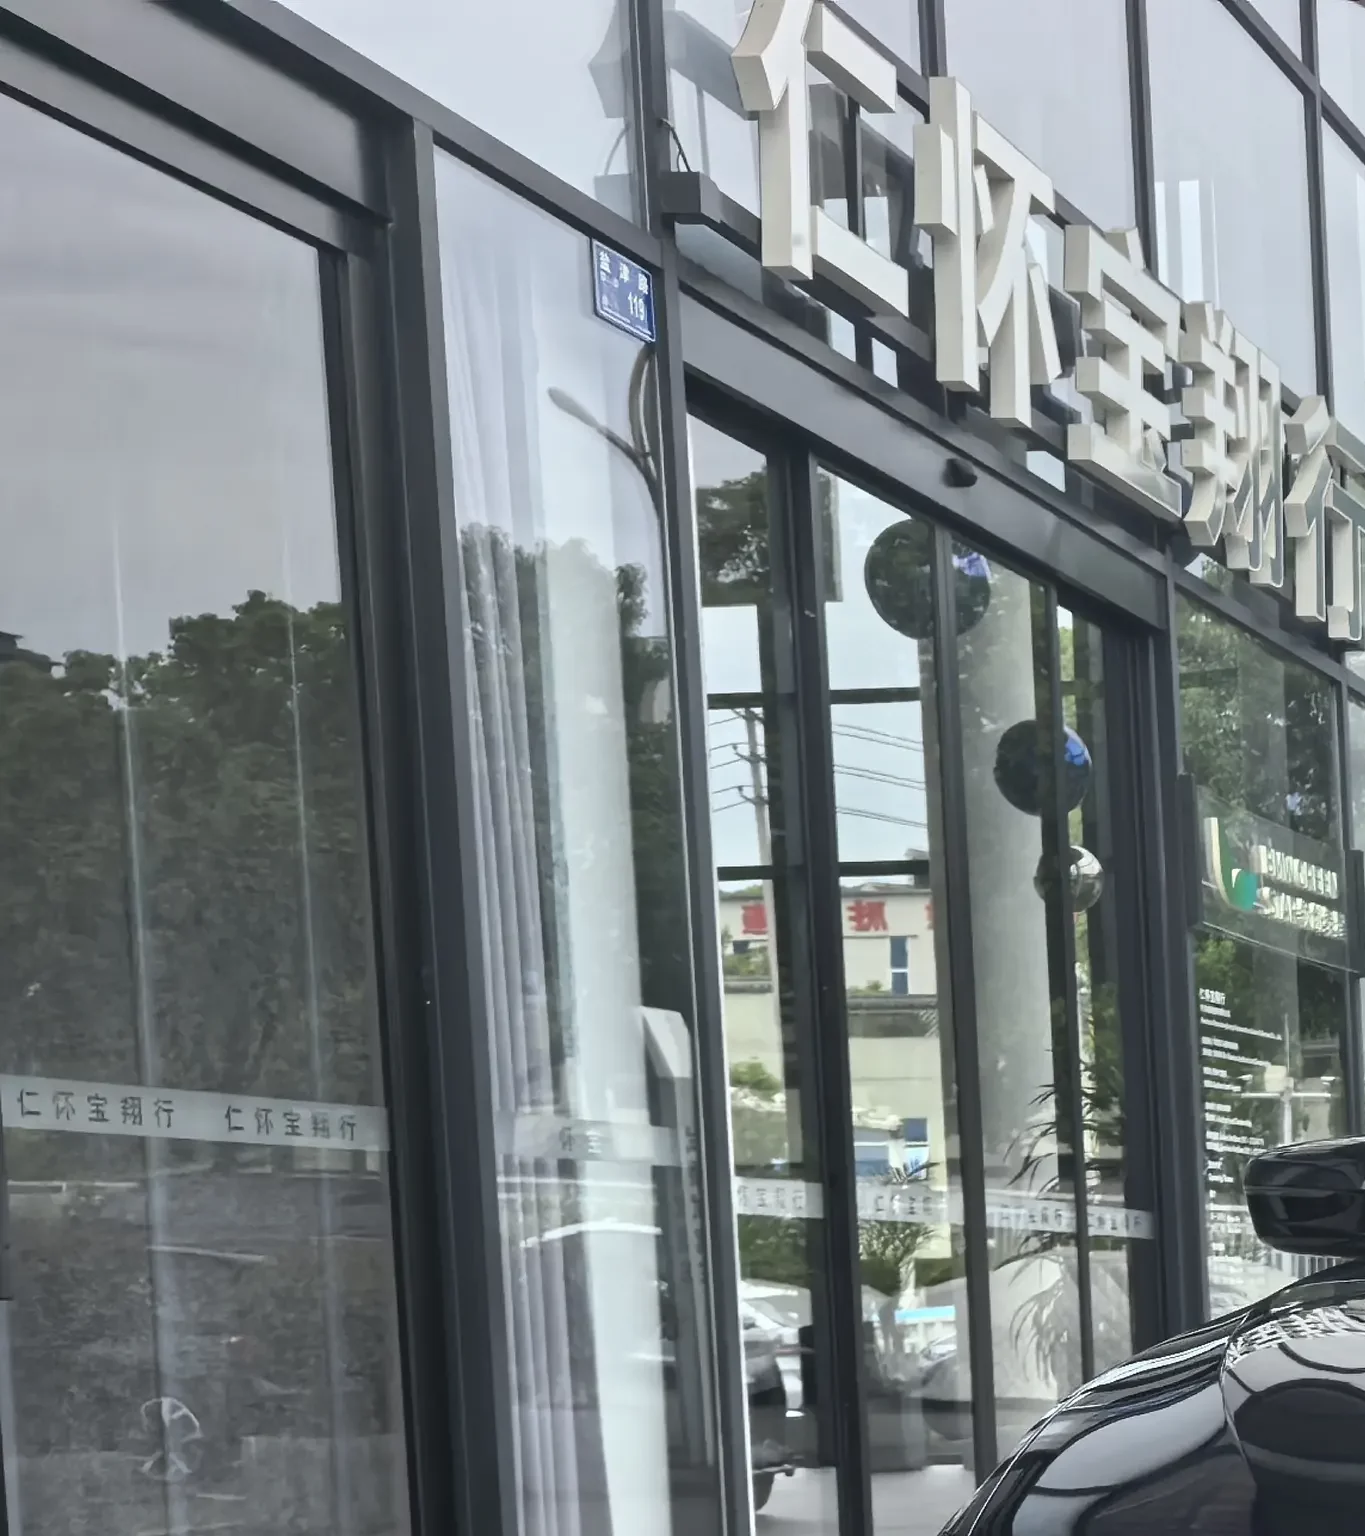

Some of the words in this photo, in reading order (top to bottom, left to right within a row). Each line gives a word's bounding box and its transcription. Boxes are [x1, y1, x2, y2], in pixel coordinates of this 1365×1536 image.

[17, 1088, 175, 1128] 仁怀宝翔行
[225, 1104, 357, 1141] 仁怀宝翔行
